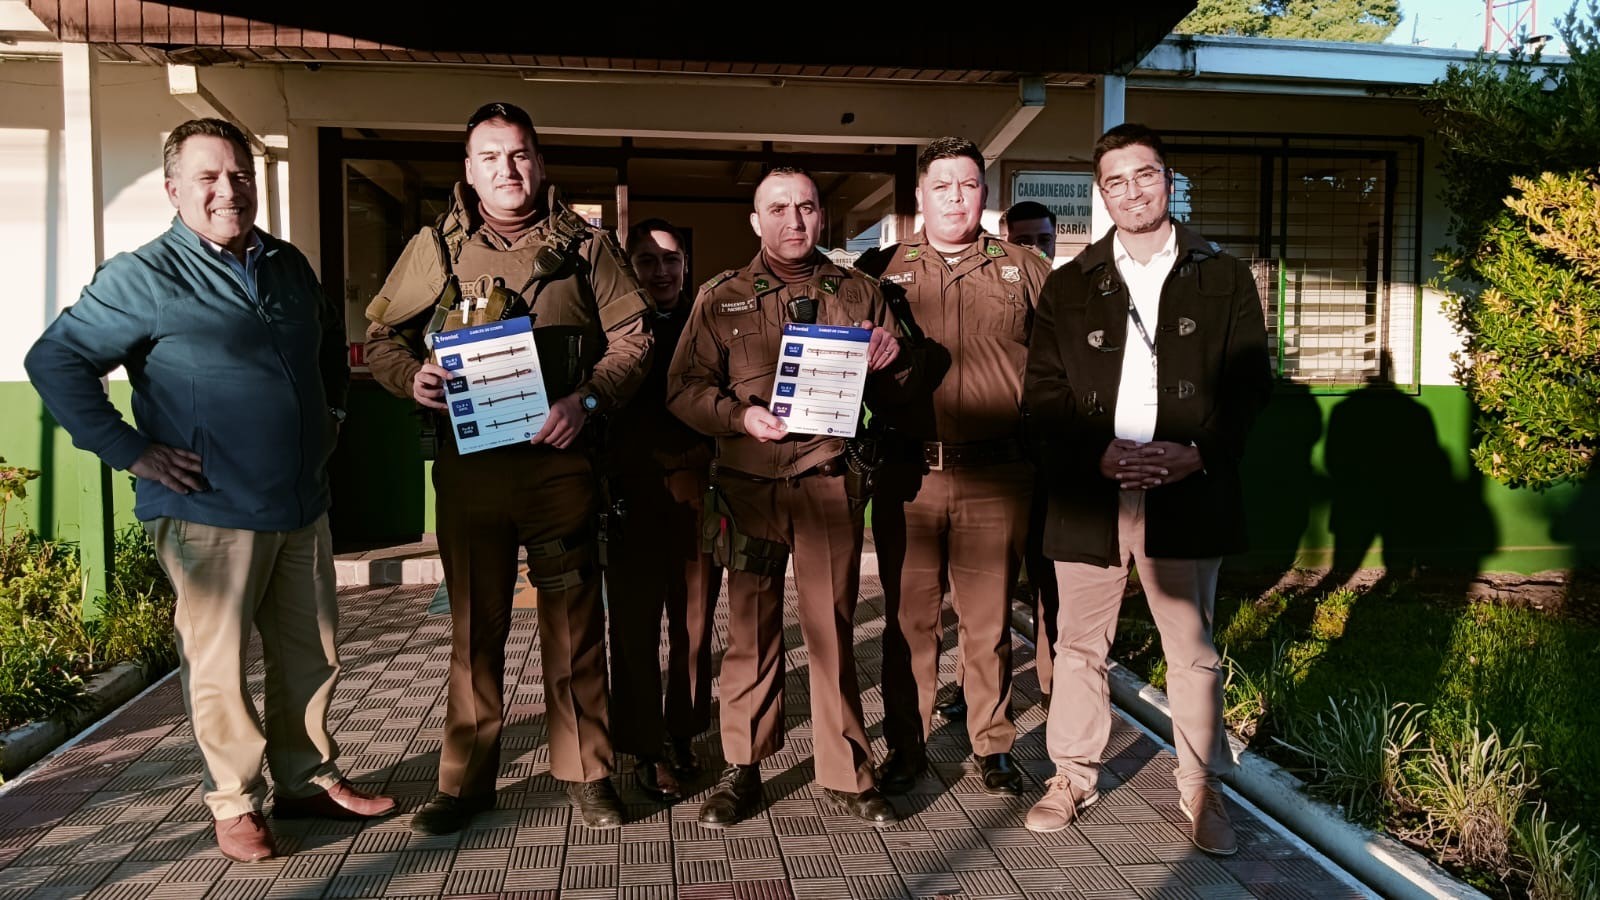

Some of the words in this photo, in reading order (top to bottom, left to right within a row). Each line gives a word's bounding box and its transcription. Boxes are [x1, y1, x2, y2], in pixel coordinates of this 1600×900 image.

[1018, 182, 1075, 198] CARABINEROS
[1077, 183, 1088, 198] DE
[1057, 221, 1087, 235] ISARÍA
